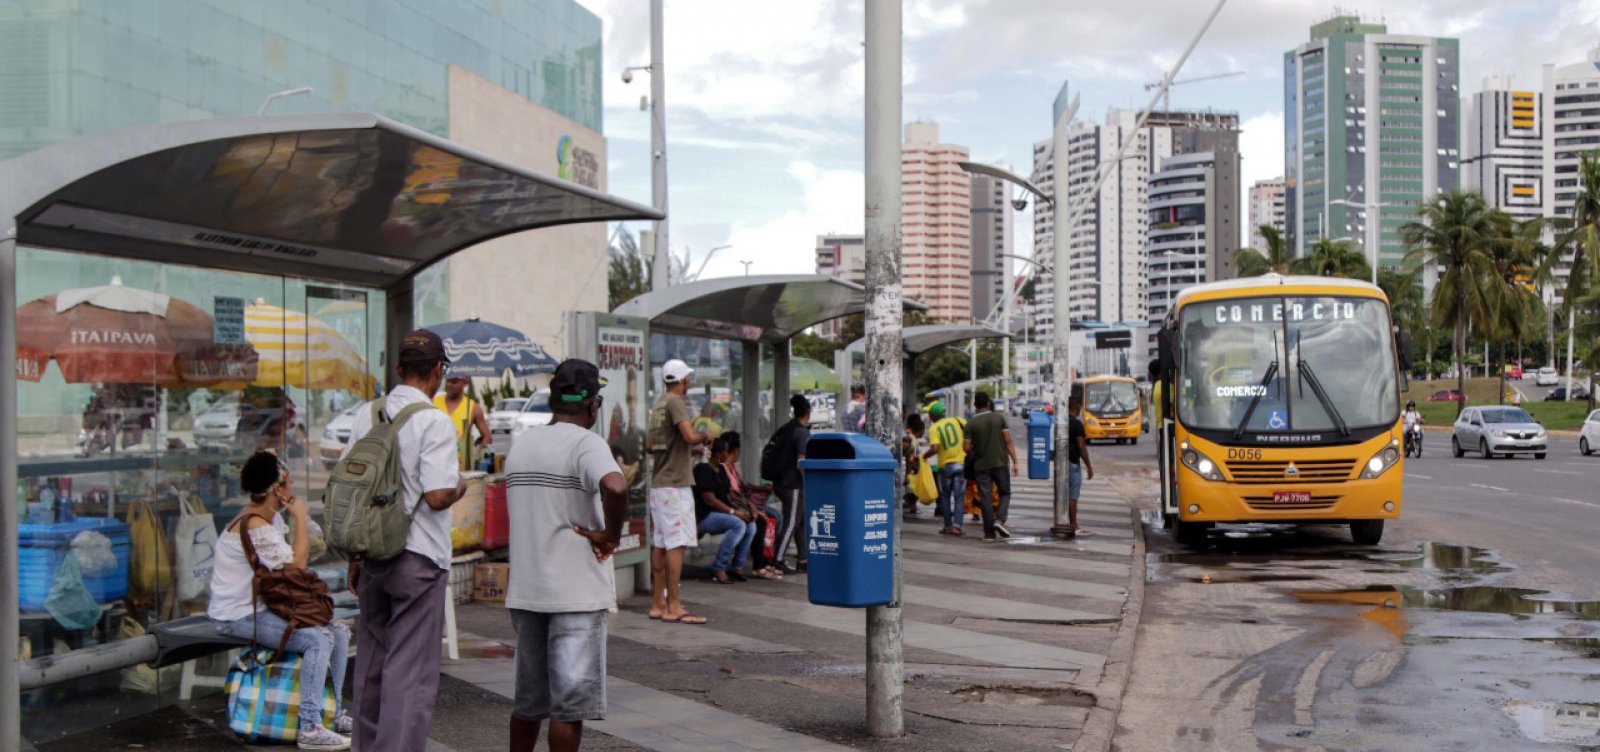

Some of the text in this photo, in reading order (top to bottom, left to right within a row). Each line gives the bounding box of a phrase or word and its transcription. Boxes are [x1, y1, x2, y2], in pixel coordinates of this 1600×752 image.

[1215, 302, 1354, 323] COMERCIO
[70, 330, 156, 345] ITAIPAVA
[937, 422, 959, 450] 10
[1228, 448, 1262, 460] D056
